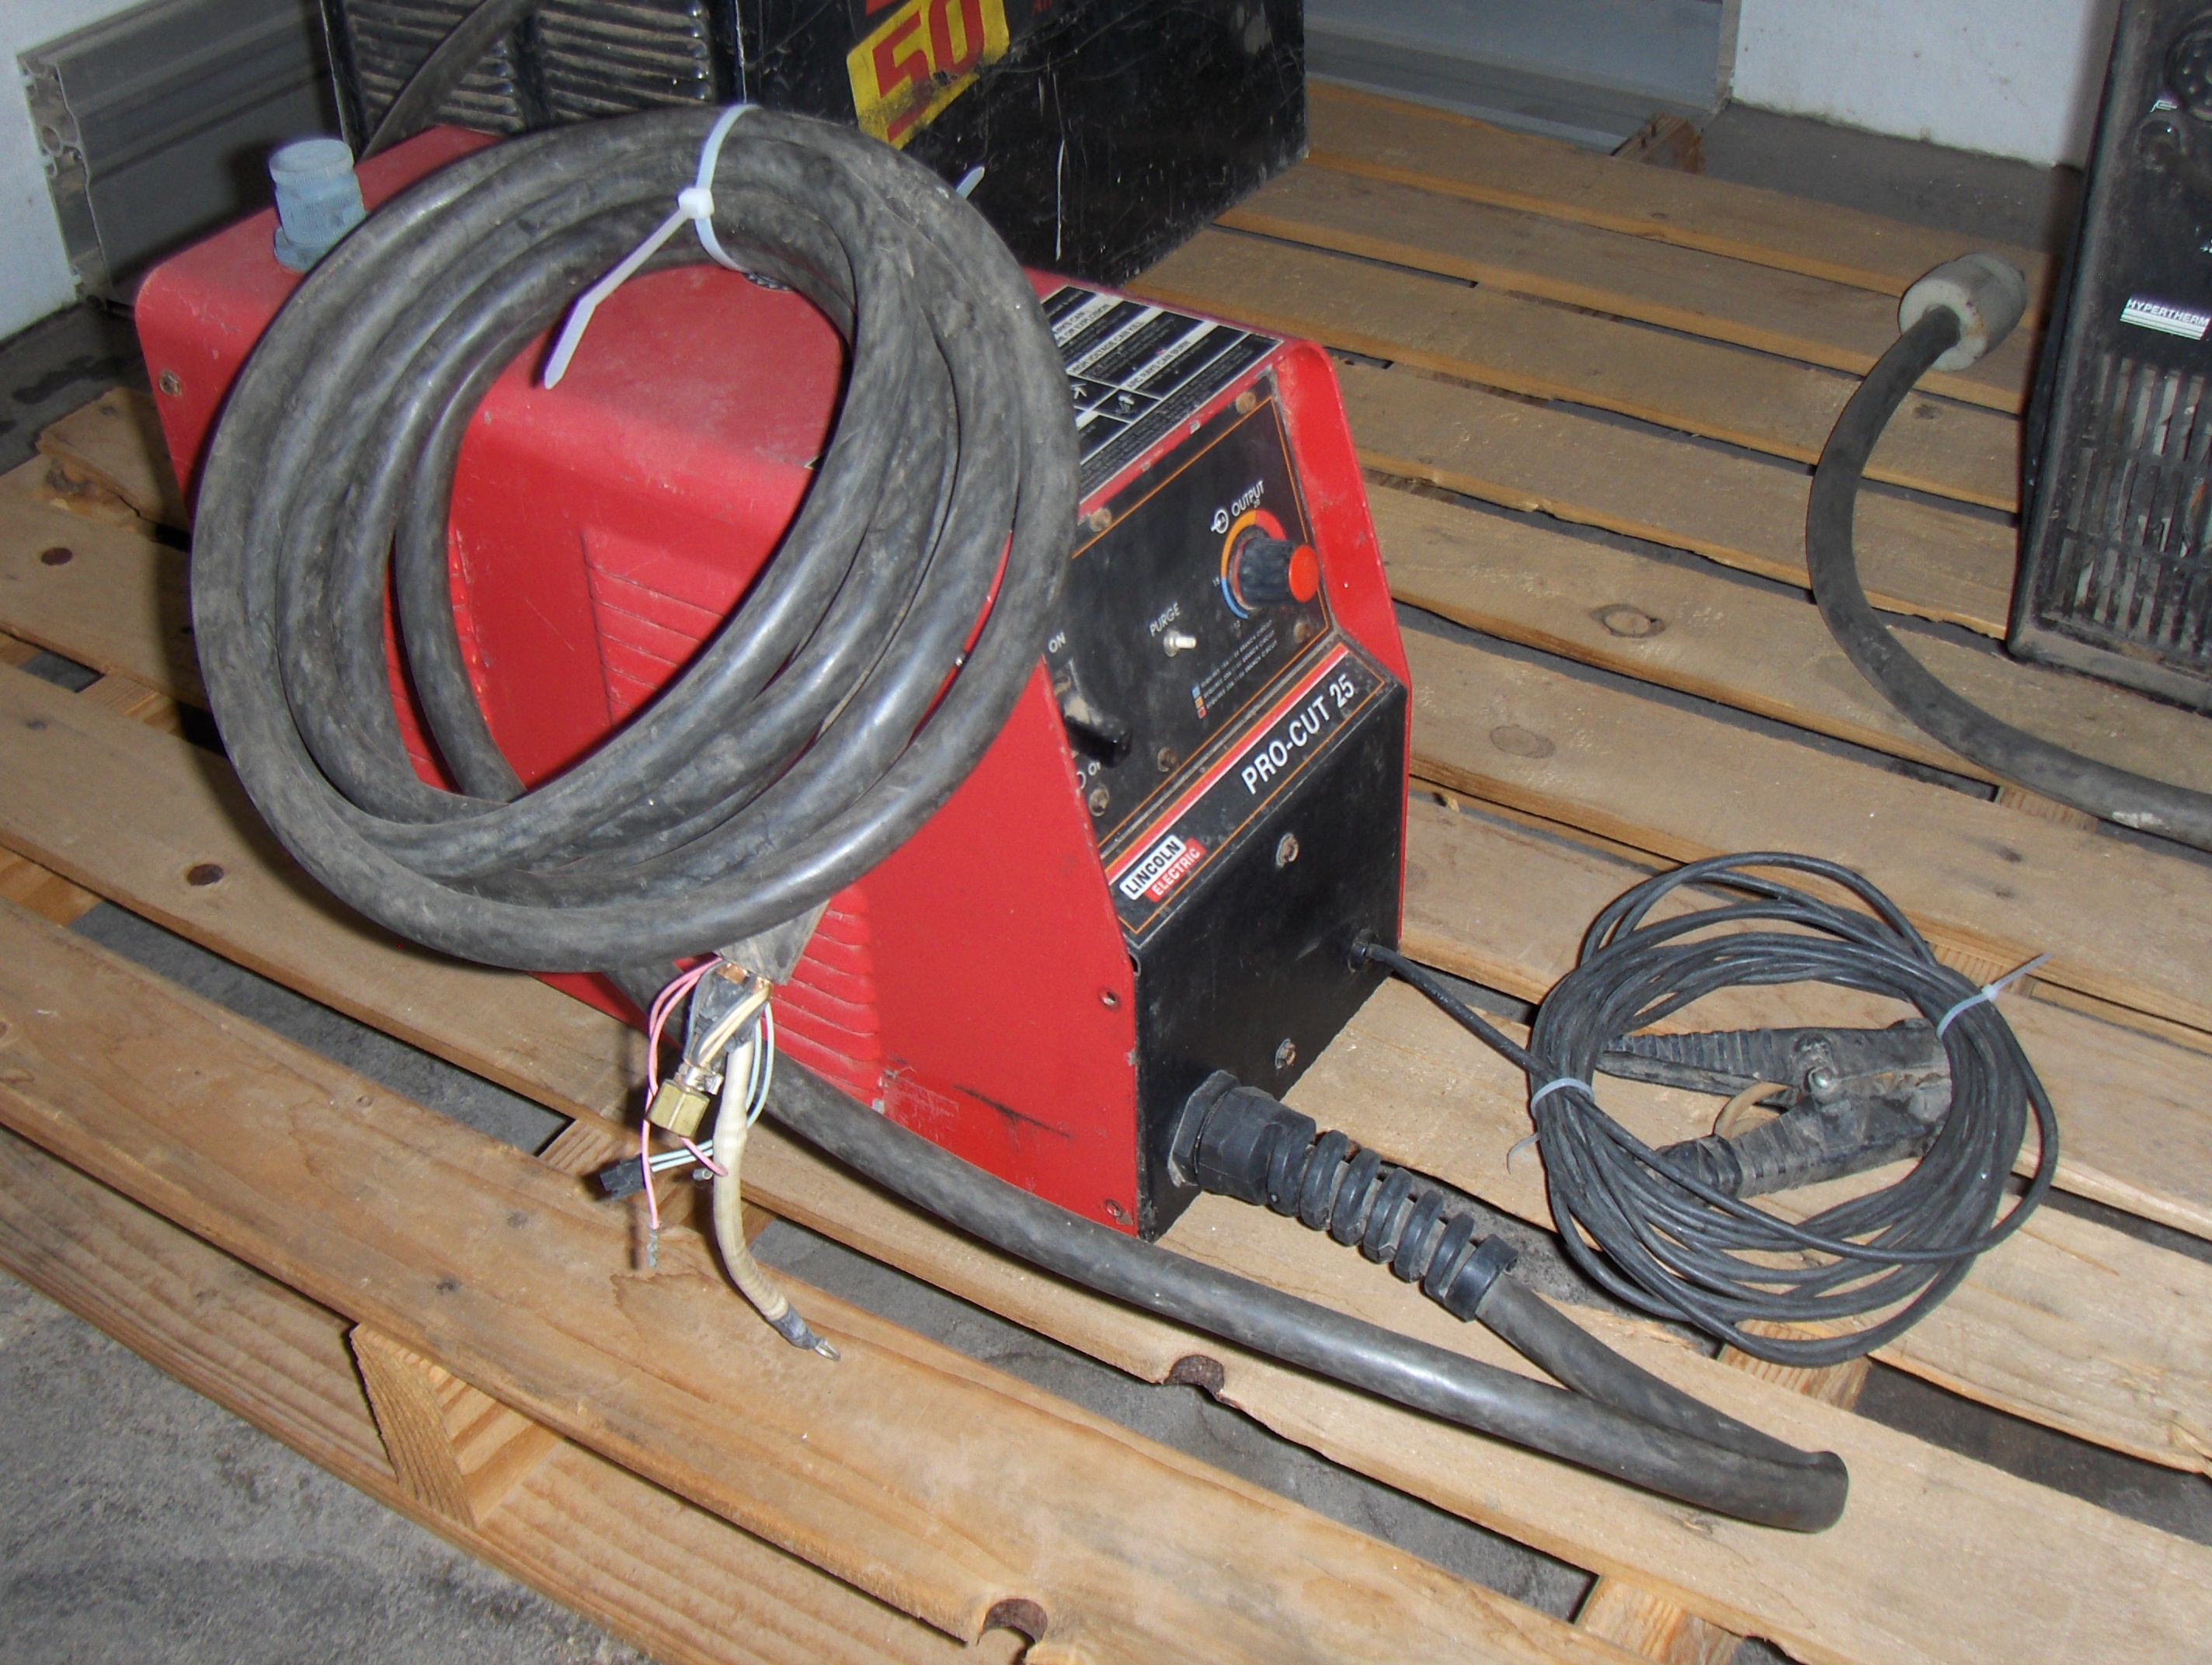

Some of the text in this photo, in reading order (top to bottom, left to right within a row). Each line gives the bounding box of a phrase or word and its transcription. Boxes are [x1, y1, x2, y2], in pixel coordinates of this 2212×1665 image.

[871, 0, 985, 144] 50
[2125, 298, 2210, 327] HYPERTHERM
[1087, 341, 1115, 361] VOLTAGE
[1112, 330, 1130, 342] CAN
[1128, 320, 1145, 330] KILL
[1127, 340, 1191, 388] ARC RAYS CAN BURN
[1232, 480, 1264, 516] OUTPUT
[1149, 603, 1181, 637] PURGE
[1256, 620, 1272, 637] CIRCUIT
[1049, 631, 1067, 653] ON
[1258, 630, 1275, 648] CIRCUIT
[1261, 640, 1278, 658] CIRCUIT
[1242, 673, 1356, 794] PRO-CUT 25
[1125, 839, 1181, 895] LINCOLN
[1152, 848, 1202, 897] ELECTRIC
